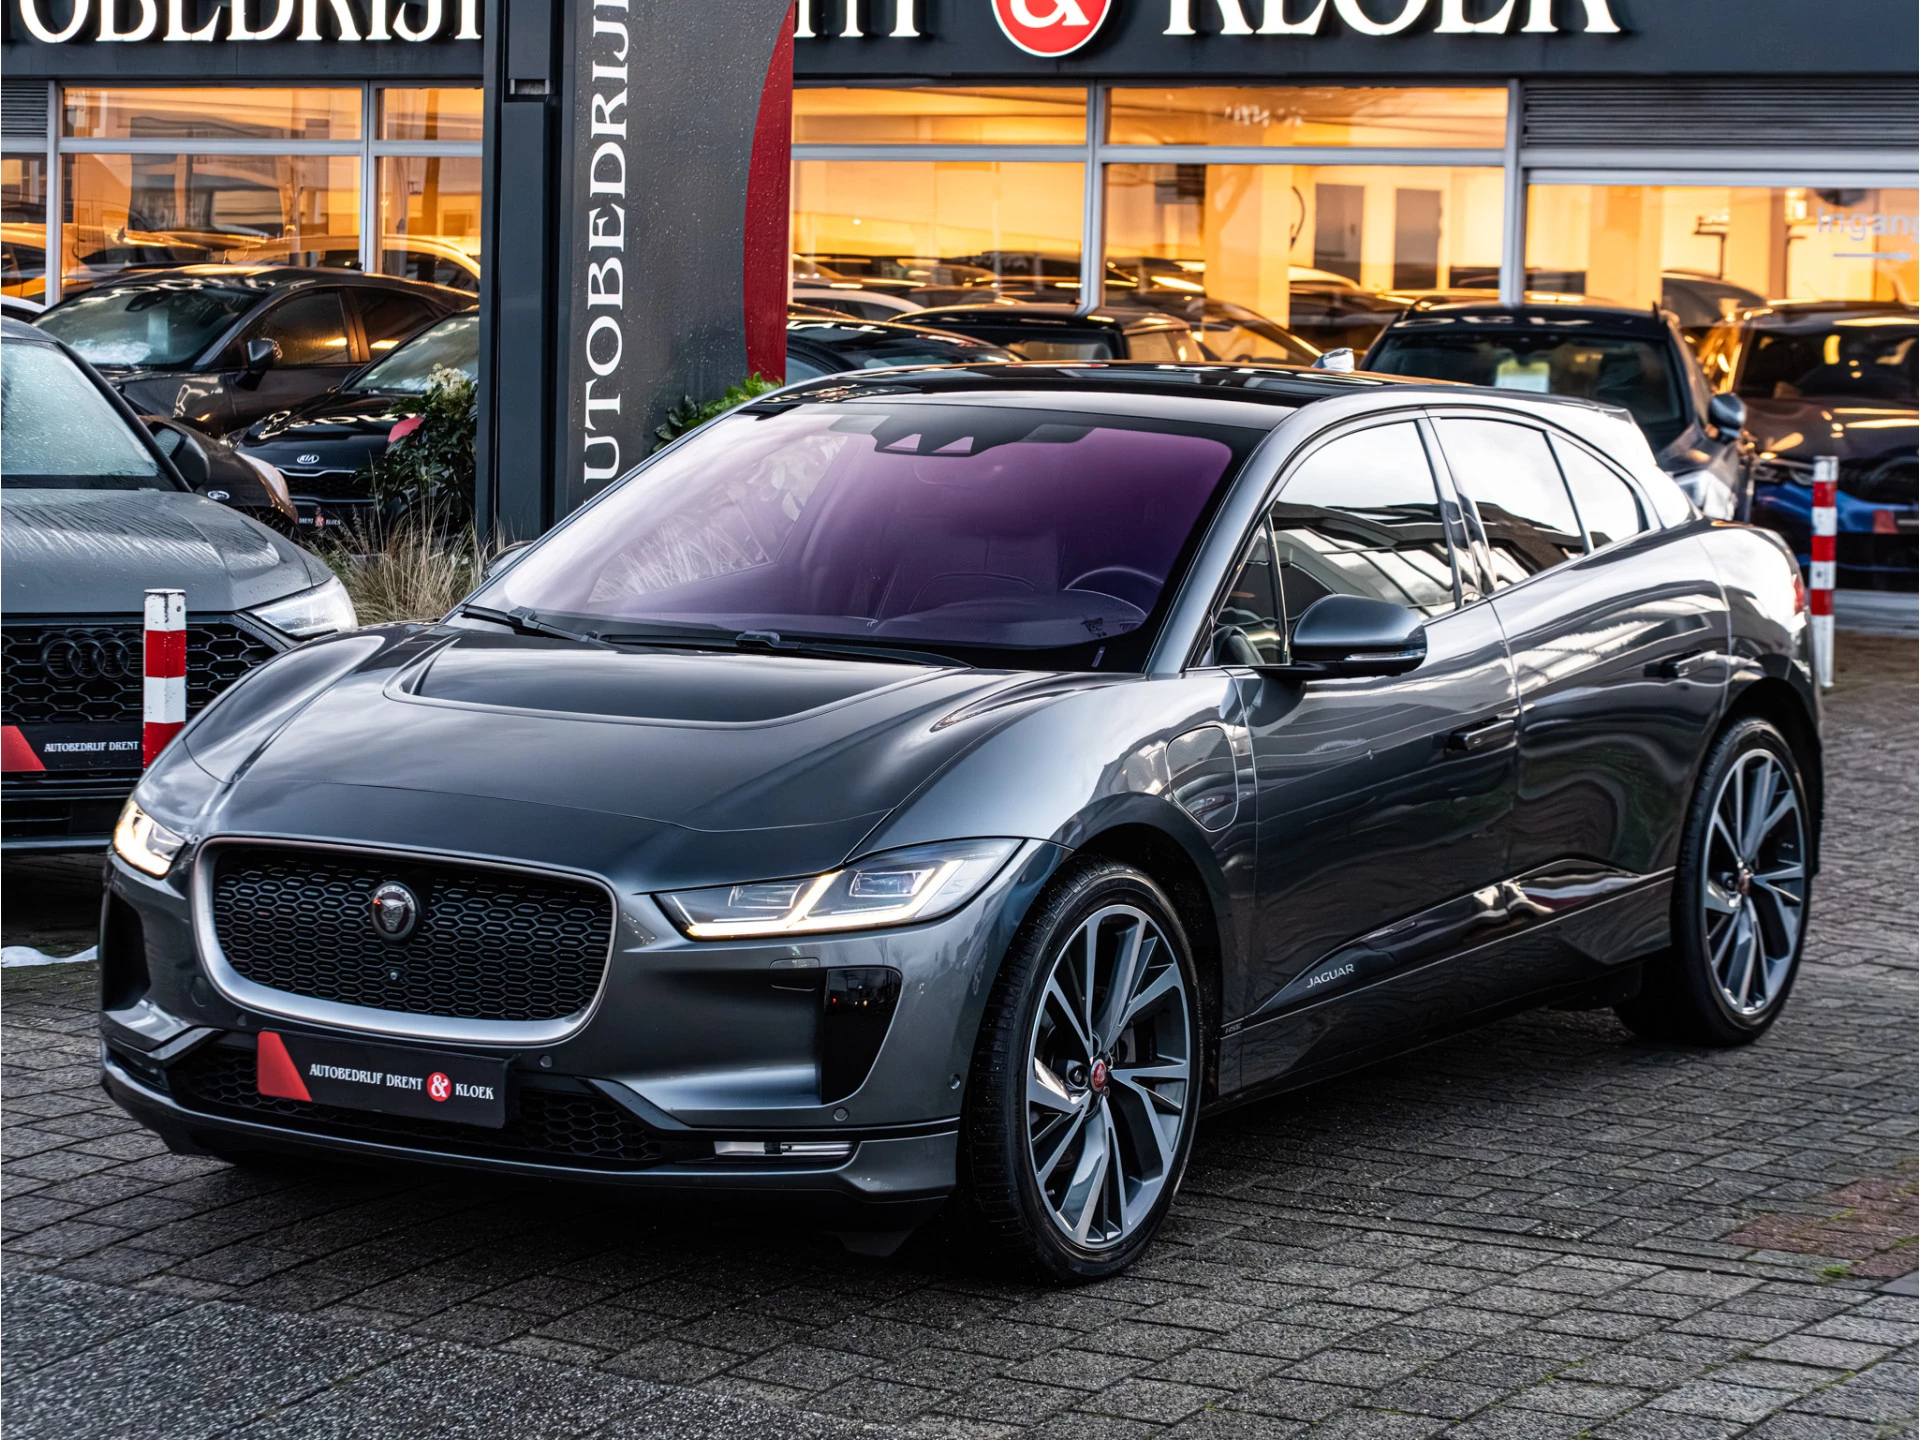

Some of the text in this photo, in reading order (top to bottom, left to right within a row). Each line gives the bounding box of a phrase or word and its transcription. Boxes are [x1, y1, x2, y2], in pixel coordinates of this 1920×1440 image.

[583, 0, 629, 503] UTOBEDRIJ
[44, 741, 140, 752] AUTOBEDRIJF DRENT
[1306, 963, 1355, 989] JAGUAR
[309, 1063, 495, 1100] AUTOBEDRIJF DRENT & KLOEK
